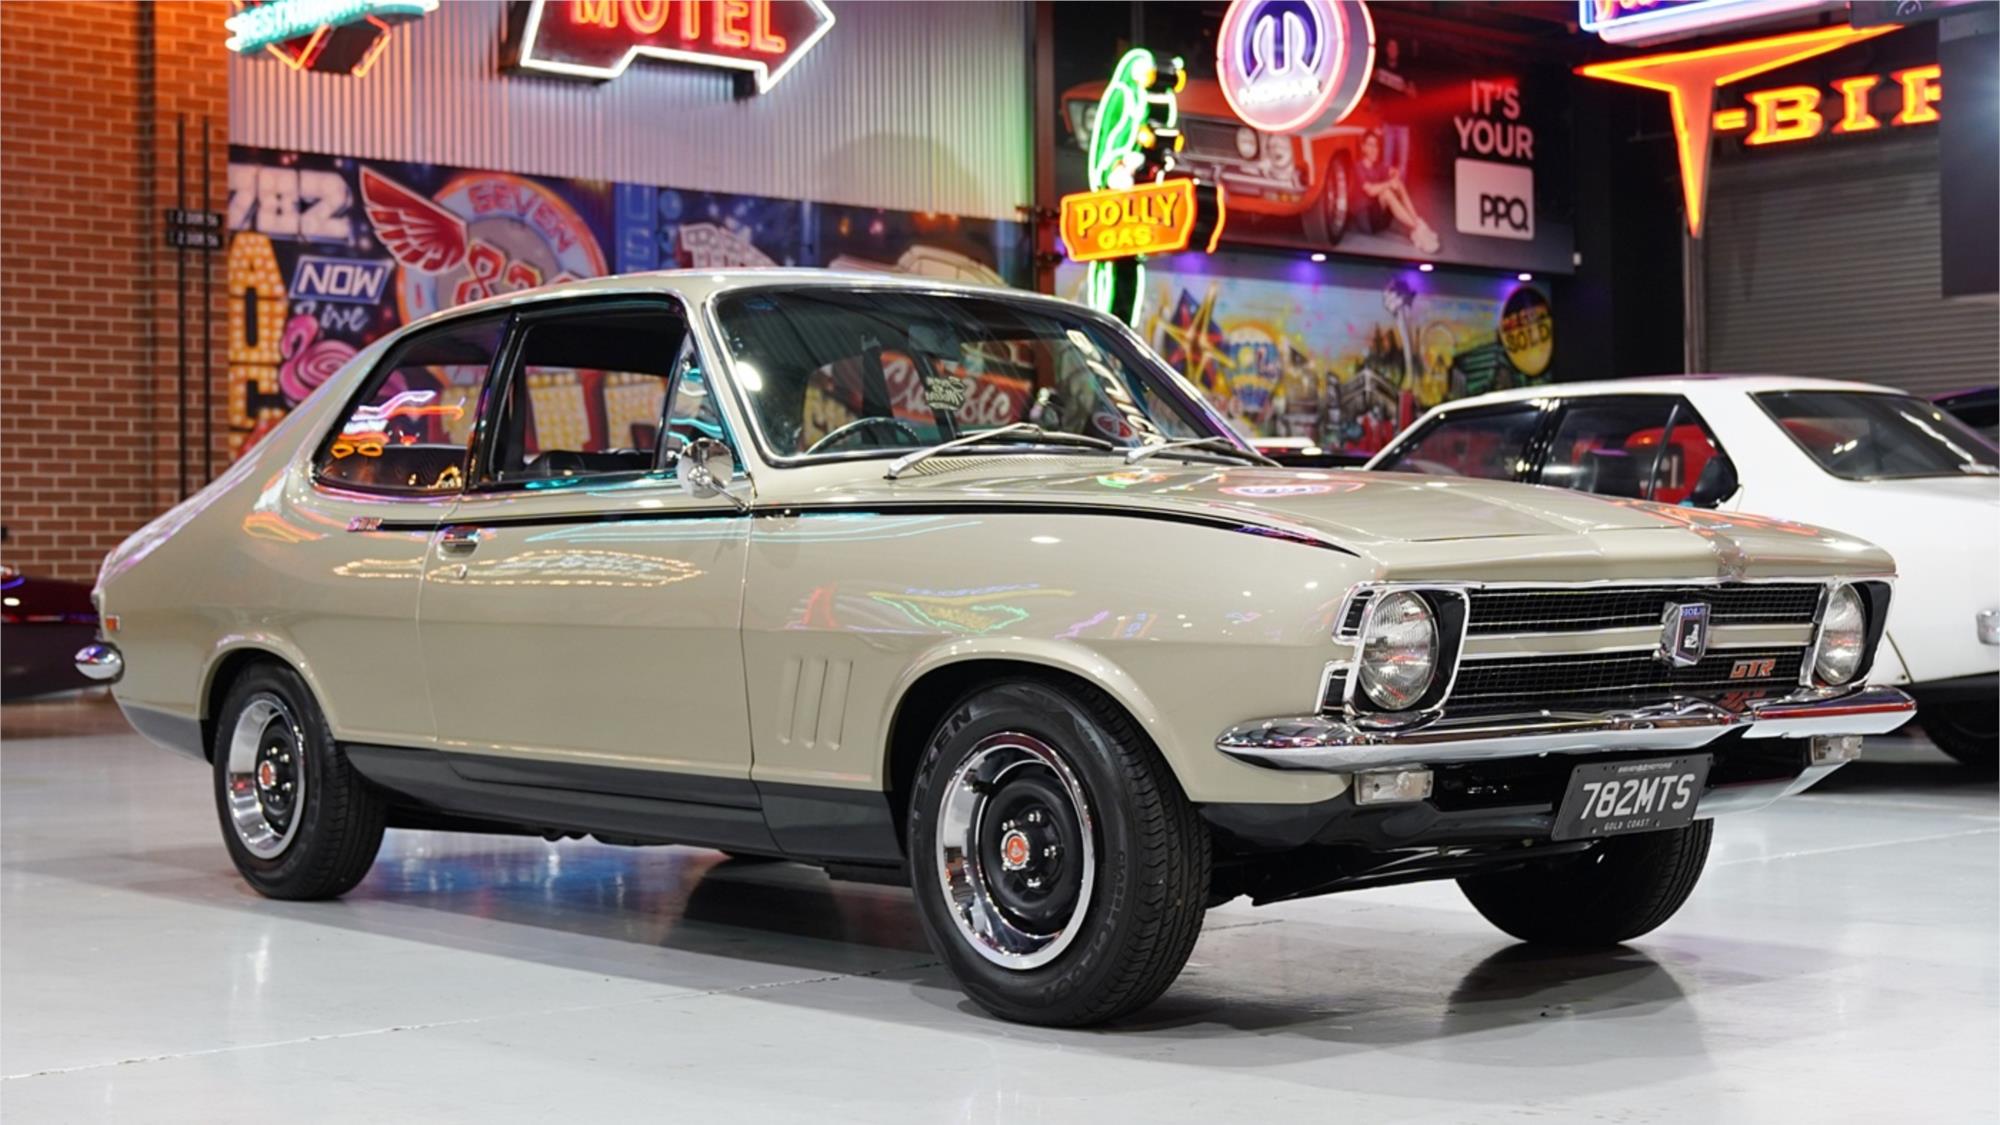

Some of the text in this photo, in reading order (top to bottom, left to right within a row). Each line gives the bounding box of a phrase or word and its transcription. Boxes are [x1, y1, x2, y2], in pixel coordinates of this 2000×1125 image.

[1471, 79, 1521, 120] IT'S
[1453, 115, 1534, 160] YOUR
[227, 164, 352, 244] 782
[1075, 191, 1178, 237] POLLY
[1479, 193, 1529, 232] PPQ
[1097, 225, 1152, 249] GAS
[297, 262, 384, 298] NOW
[1730, 659, 1776, 679] GTR
[1580, 774, 1696, 820] 782MTS
